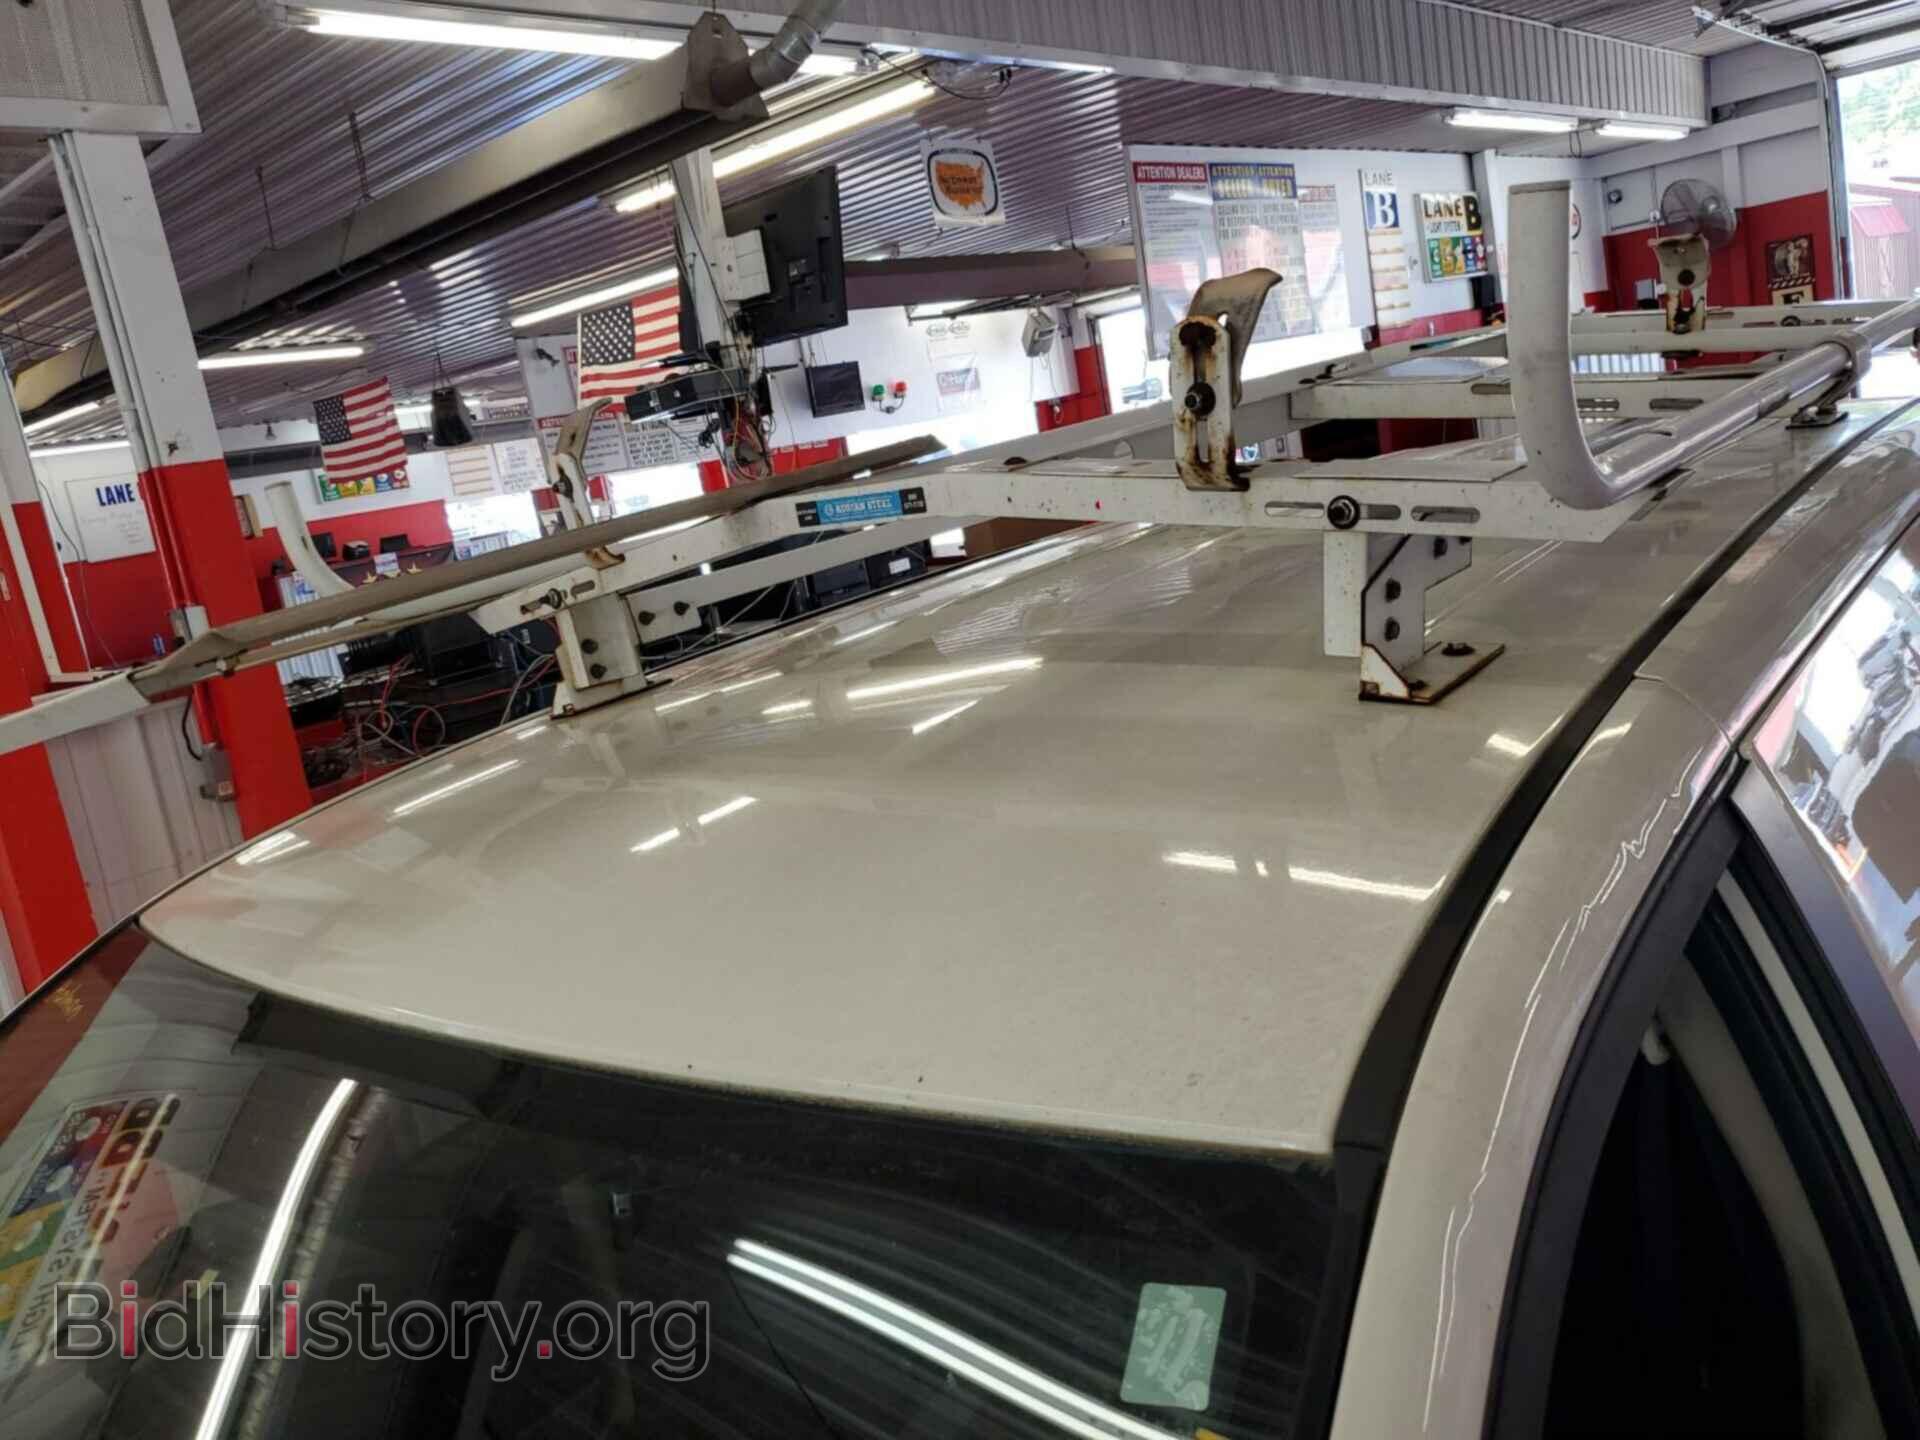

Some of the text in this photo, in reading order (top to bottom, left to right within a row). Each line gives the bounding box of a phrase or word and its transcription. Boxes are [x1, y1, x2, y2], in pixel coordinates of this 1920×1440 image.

[1137, 165, 1206, 181] ATTENTION DEALERS
[1364, 171, 1393, 186] LANE
[1374, 191, 1396, 228] B
[1423, 195, 1482, 231] LANE B
[96, 483, 136, 507] LANE
